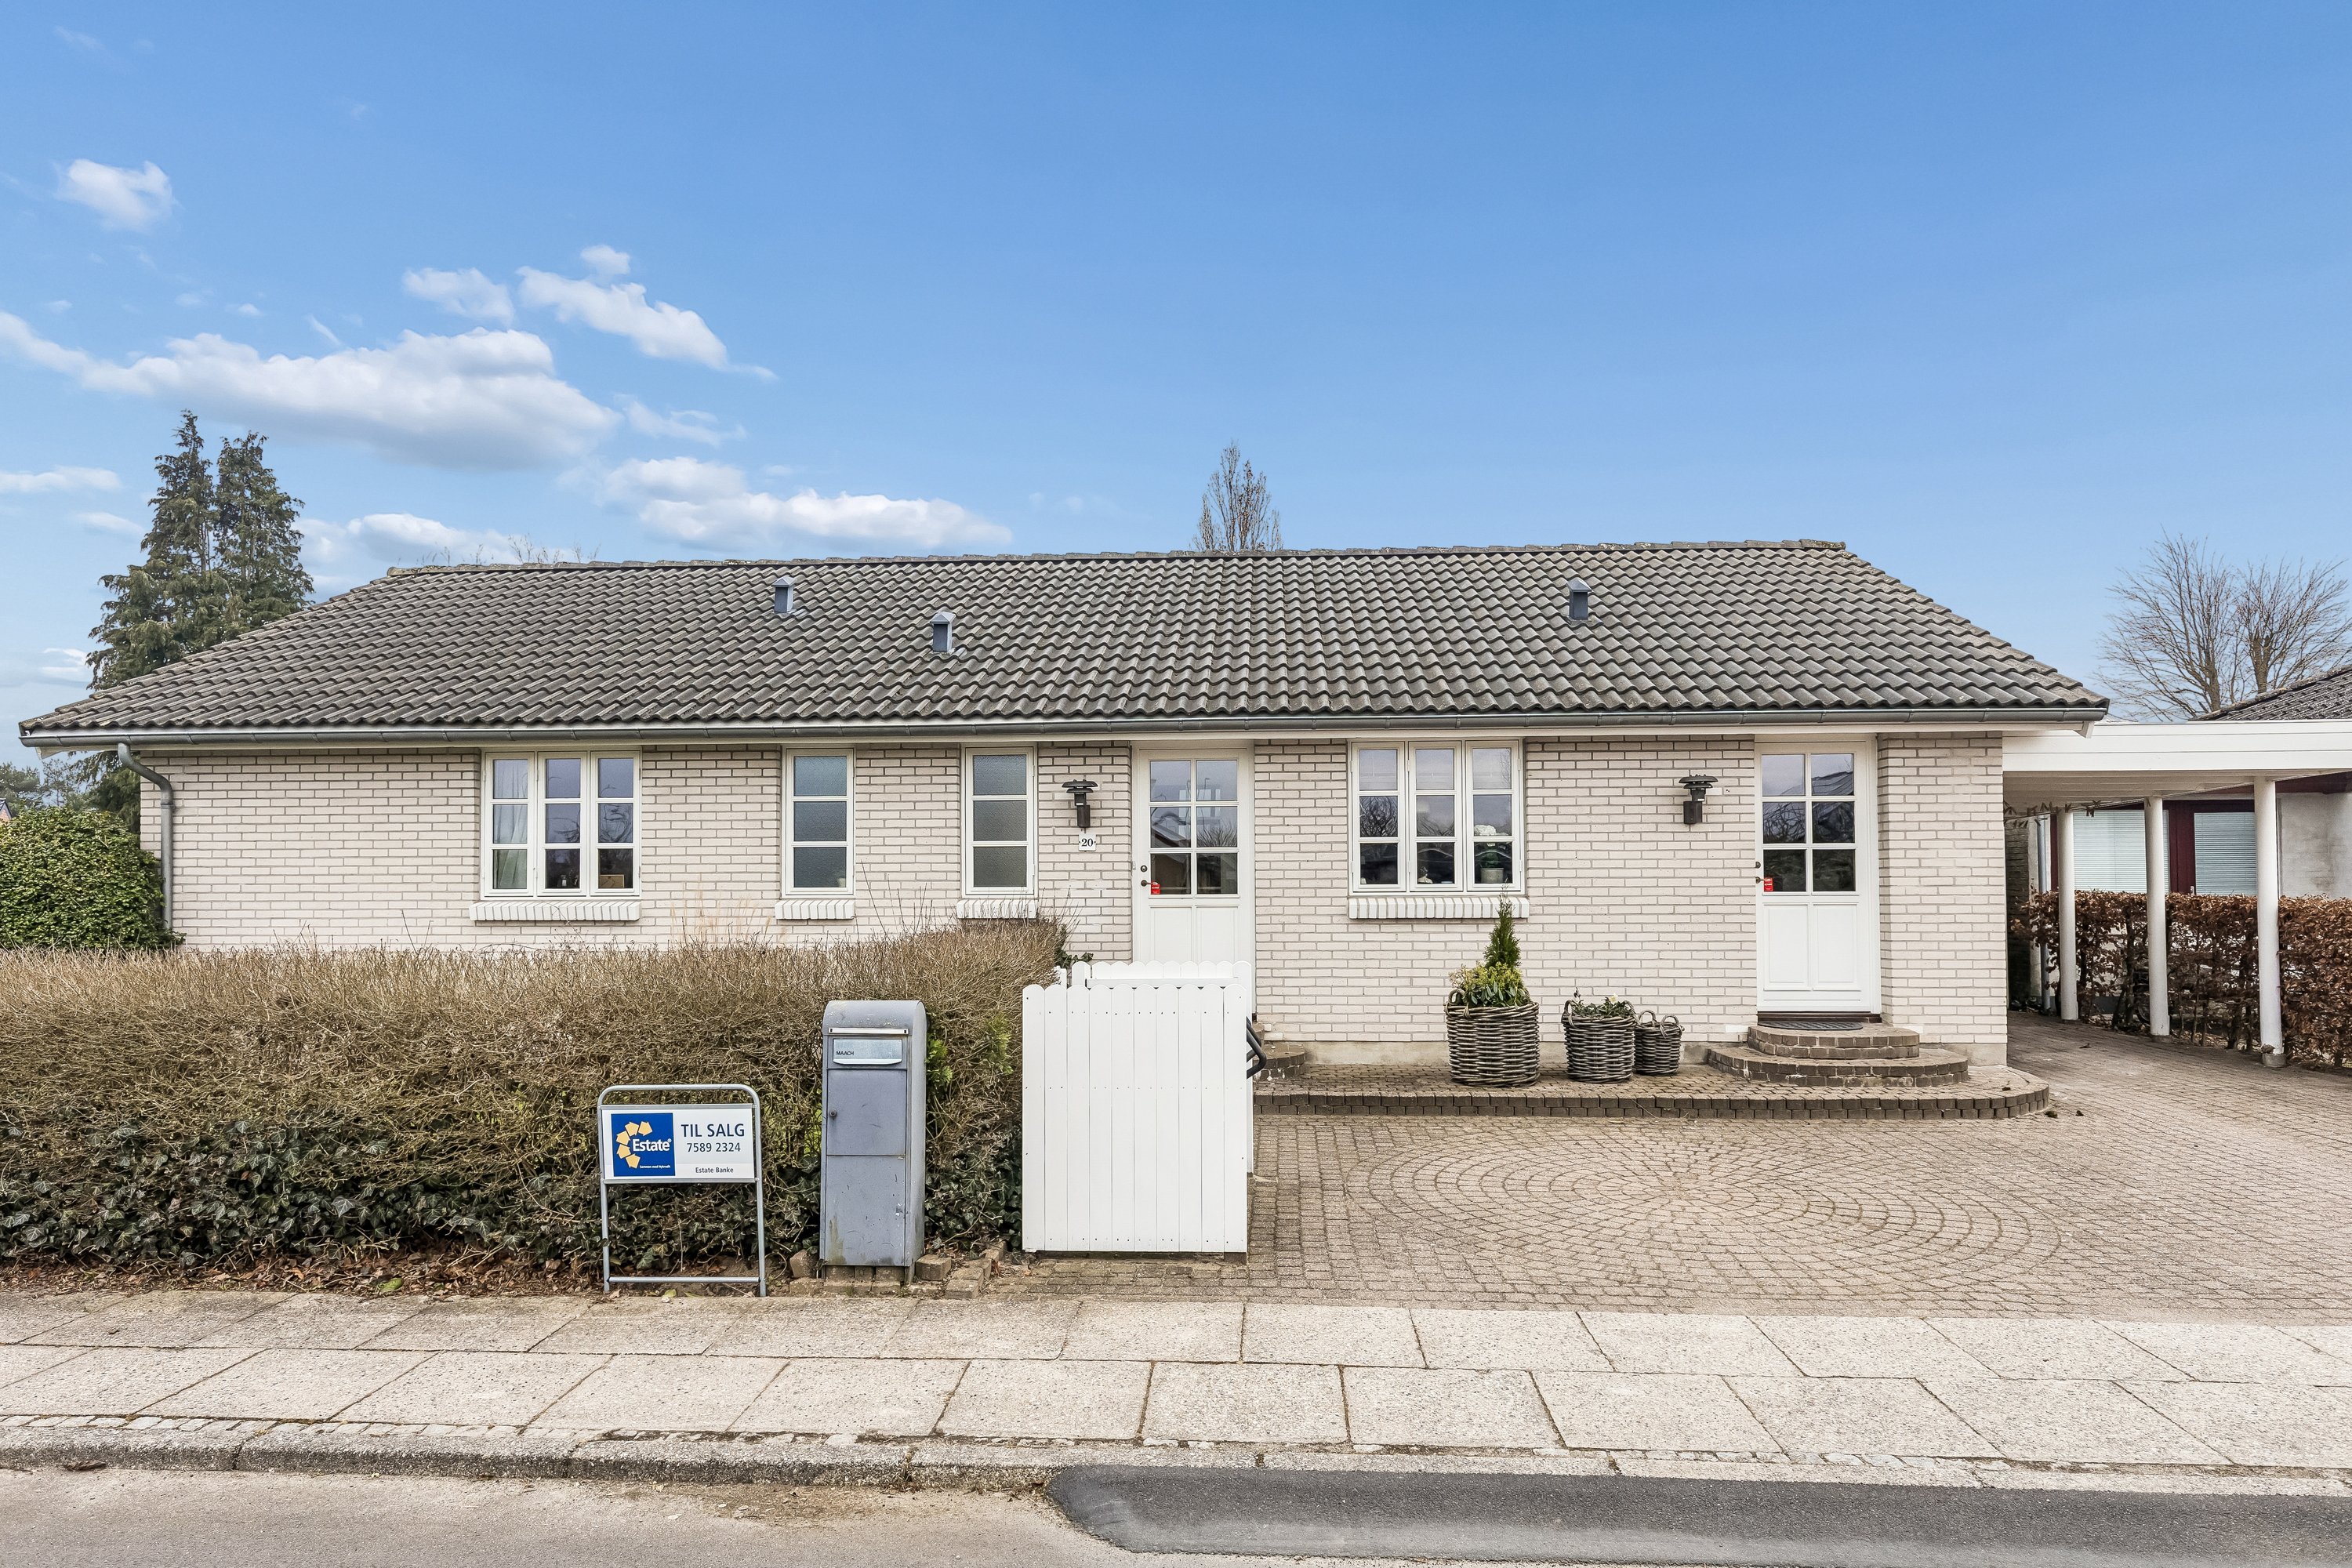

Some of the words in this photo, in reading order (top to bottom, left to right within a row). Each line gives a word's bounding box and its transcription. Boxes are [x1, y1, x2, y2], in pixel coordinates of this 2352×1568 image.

[1081, 838, 1094, 847] 20
[681, 1123, 702, 1137] TIL
[707, 1123, 744, 1137] SALG
[687, 1142, 712, 1152] 7589
[715, 1142, 741, 1152] 2324
